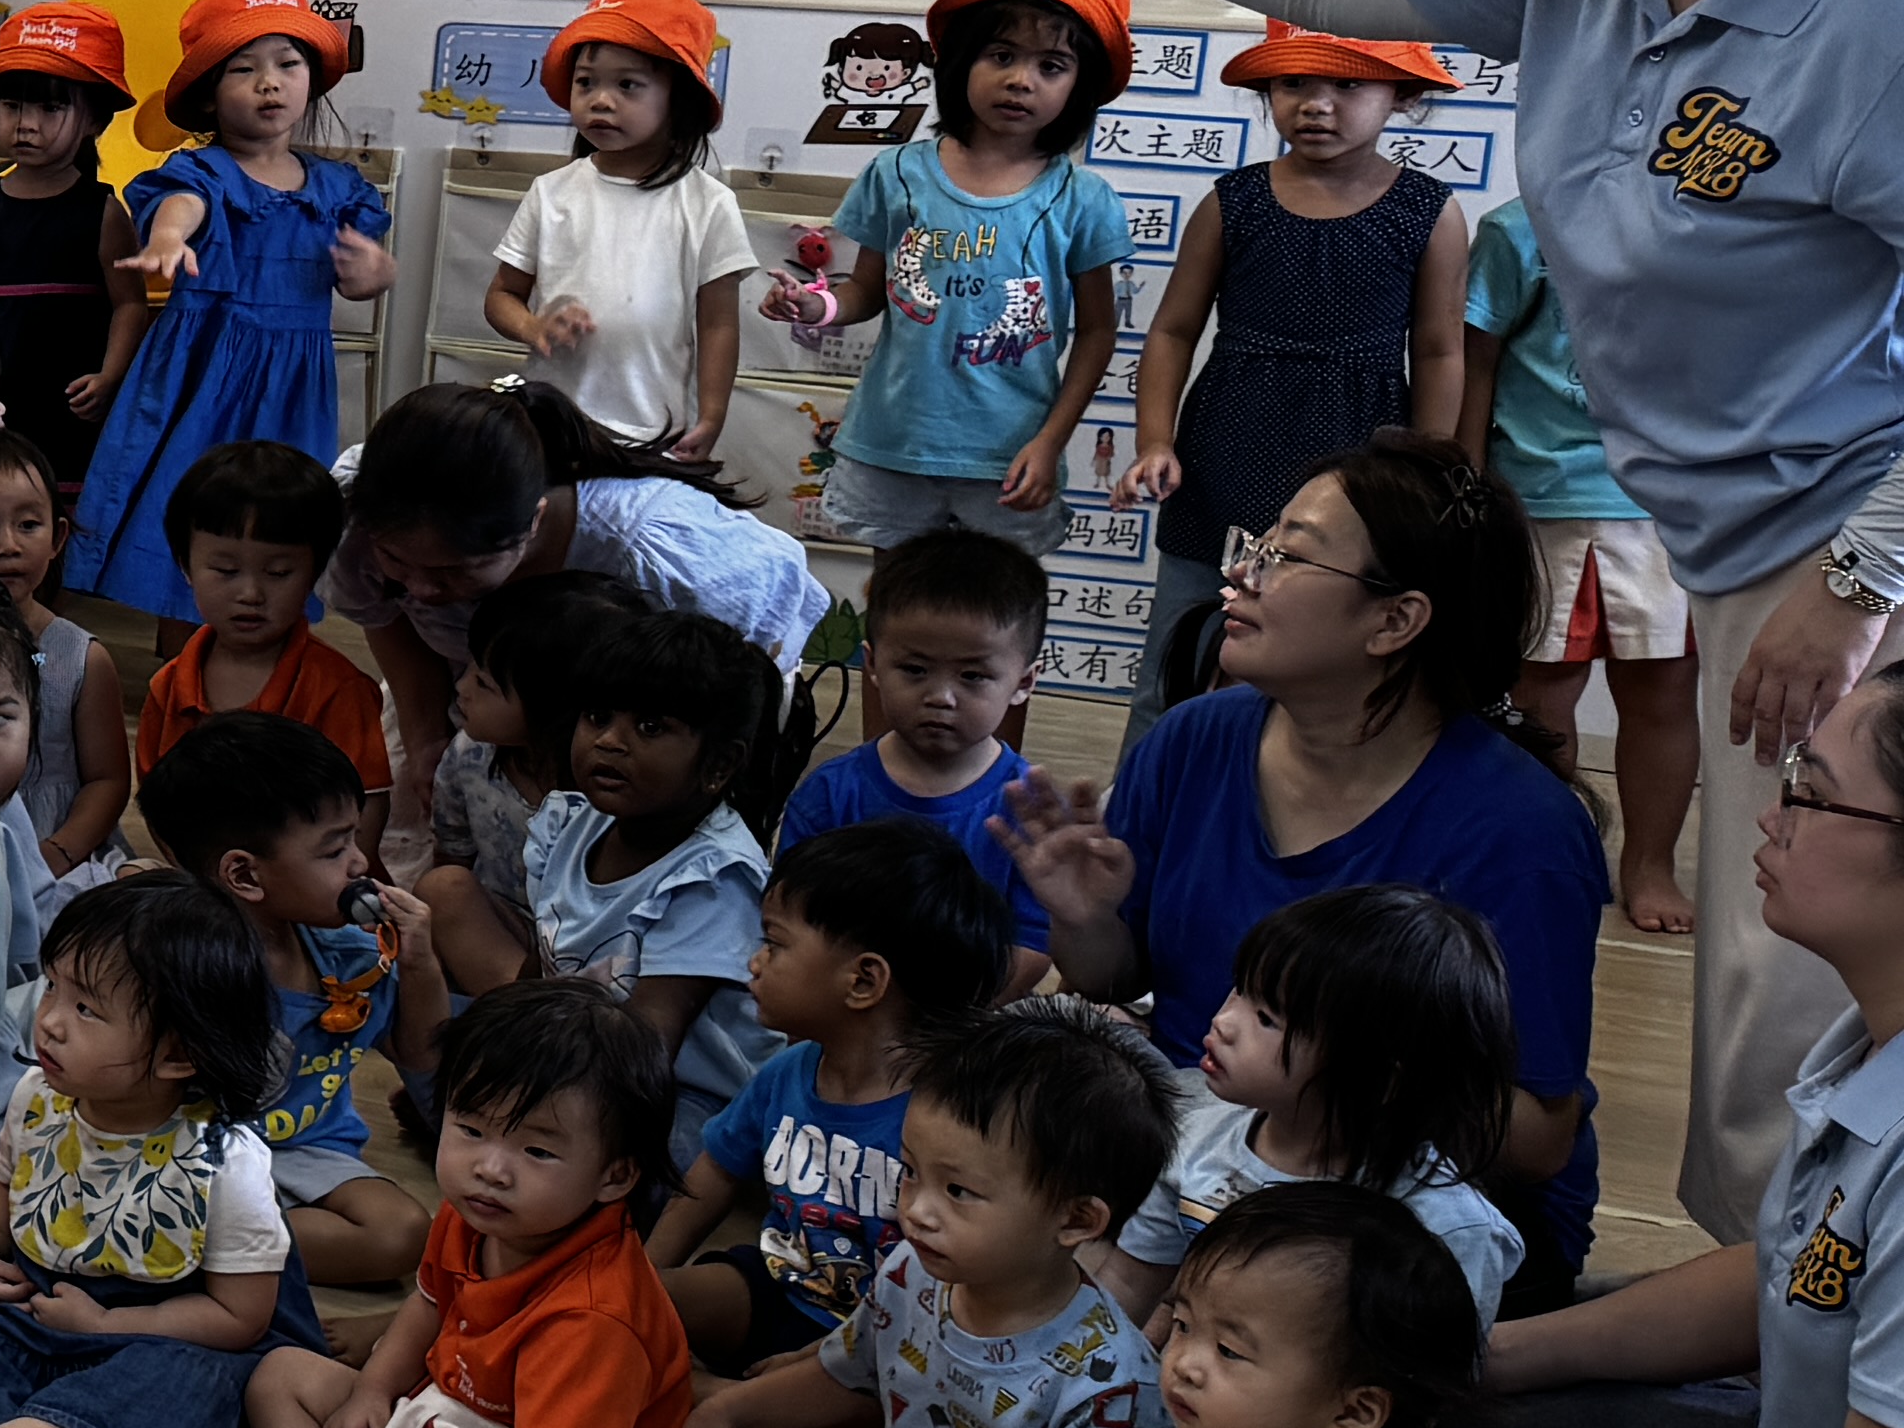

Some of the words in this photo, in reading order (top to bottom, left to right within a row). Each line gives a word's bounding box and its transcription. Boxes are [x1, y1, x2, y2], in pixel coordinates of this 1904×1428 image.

[1093, 119, 1227, 164] 次主题
[1666, 92, 1774, 167] Team
[1389, 133, 1480, 173] 家人
[910, 223, 998, 263] YEAH
[944, 273, 985, 299] It's
[951, 330, 1029, 367] FUN
[1065, 513, 1140, 552] 妈妈
[297, 1040, 364, 1077] Let's
